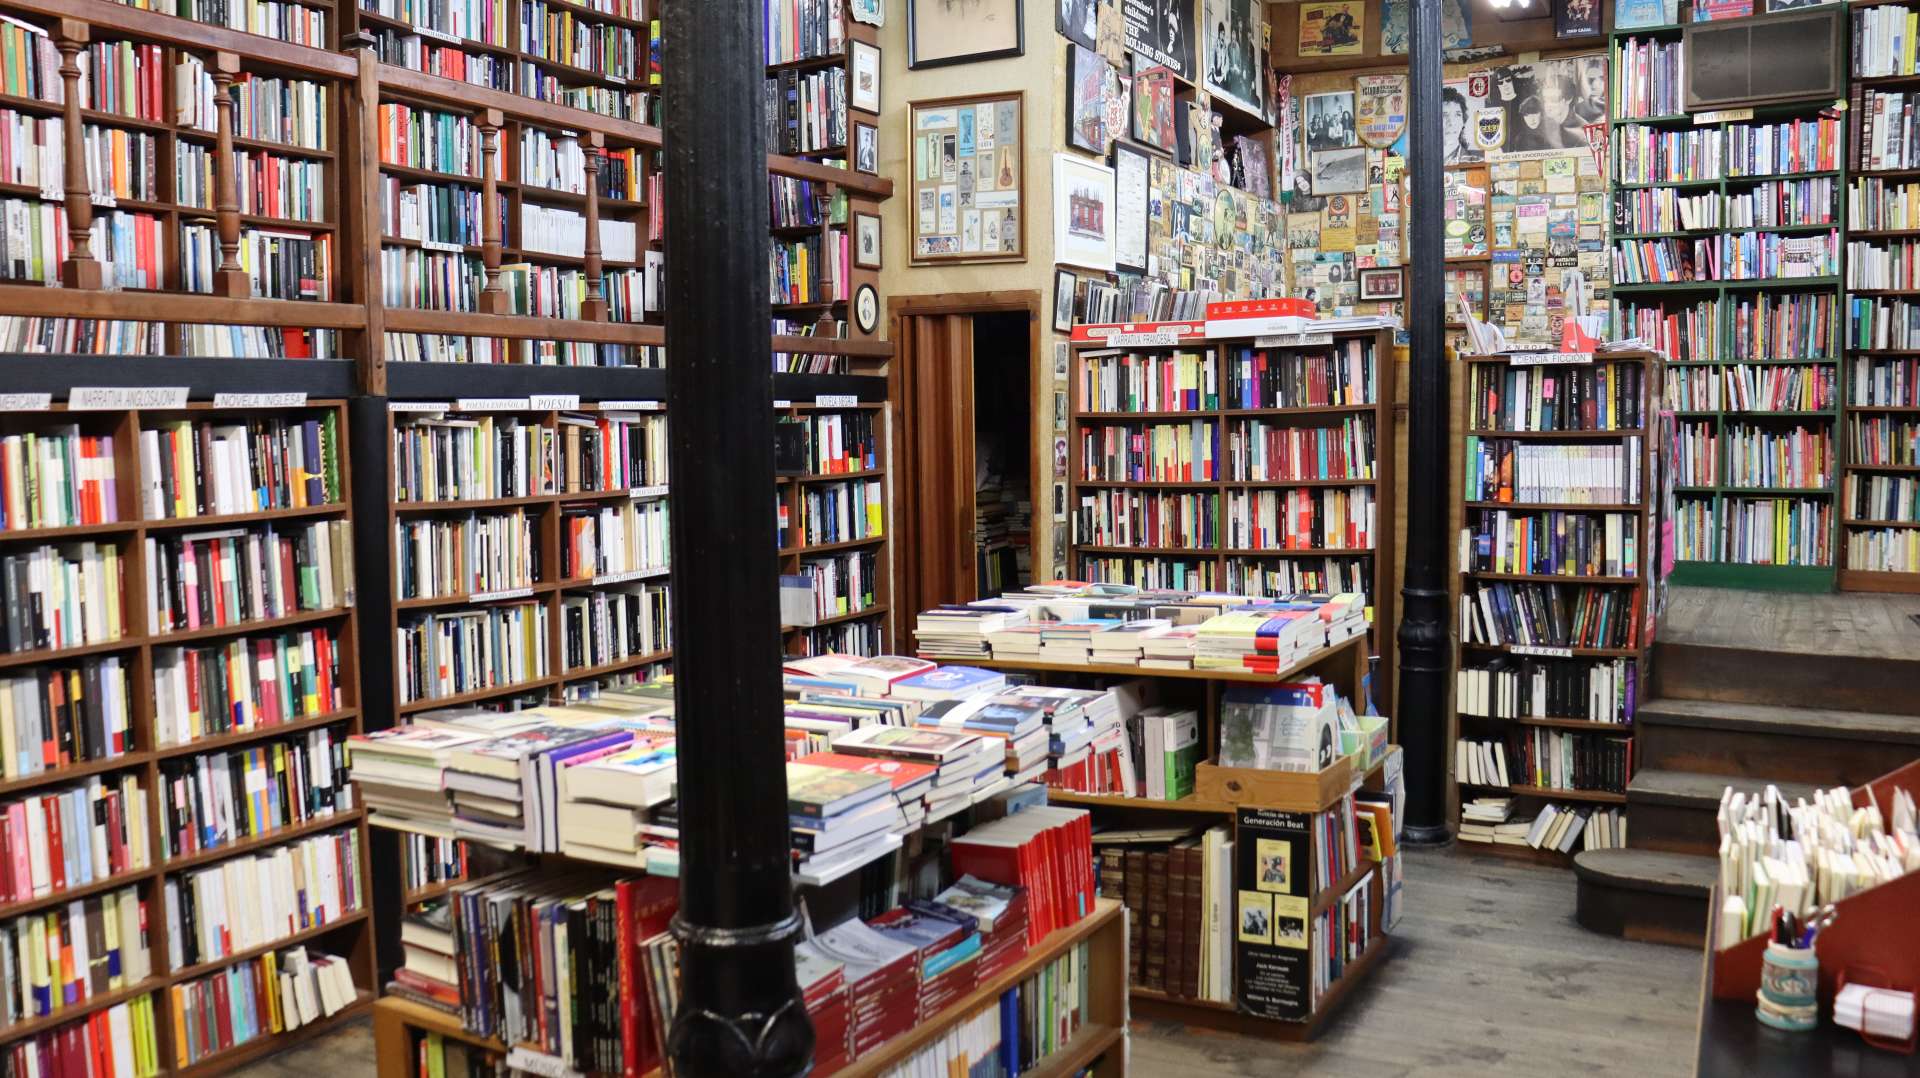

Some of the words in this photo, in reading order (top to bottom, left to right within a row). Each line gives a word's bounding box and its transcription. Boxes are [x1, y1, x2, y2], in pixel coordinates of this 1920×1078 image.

[1124, 33, 1154, 58] ROLLING
[1142, 332, 1171, 345] FRANCESA
[1517, 355, 1549, 364] CIENCIA
[220, 394, 260, 407] NOVELA
[1243, 816, 1285, 827] Generación
[1286, 820, 1304, 829] Beat
